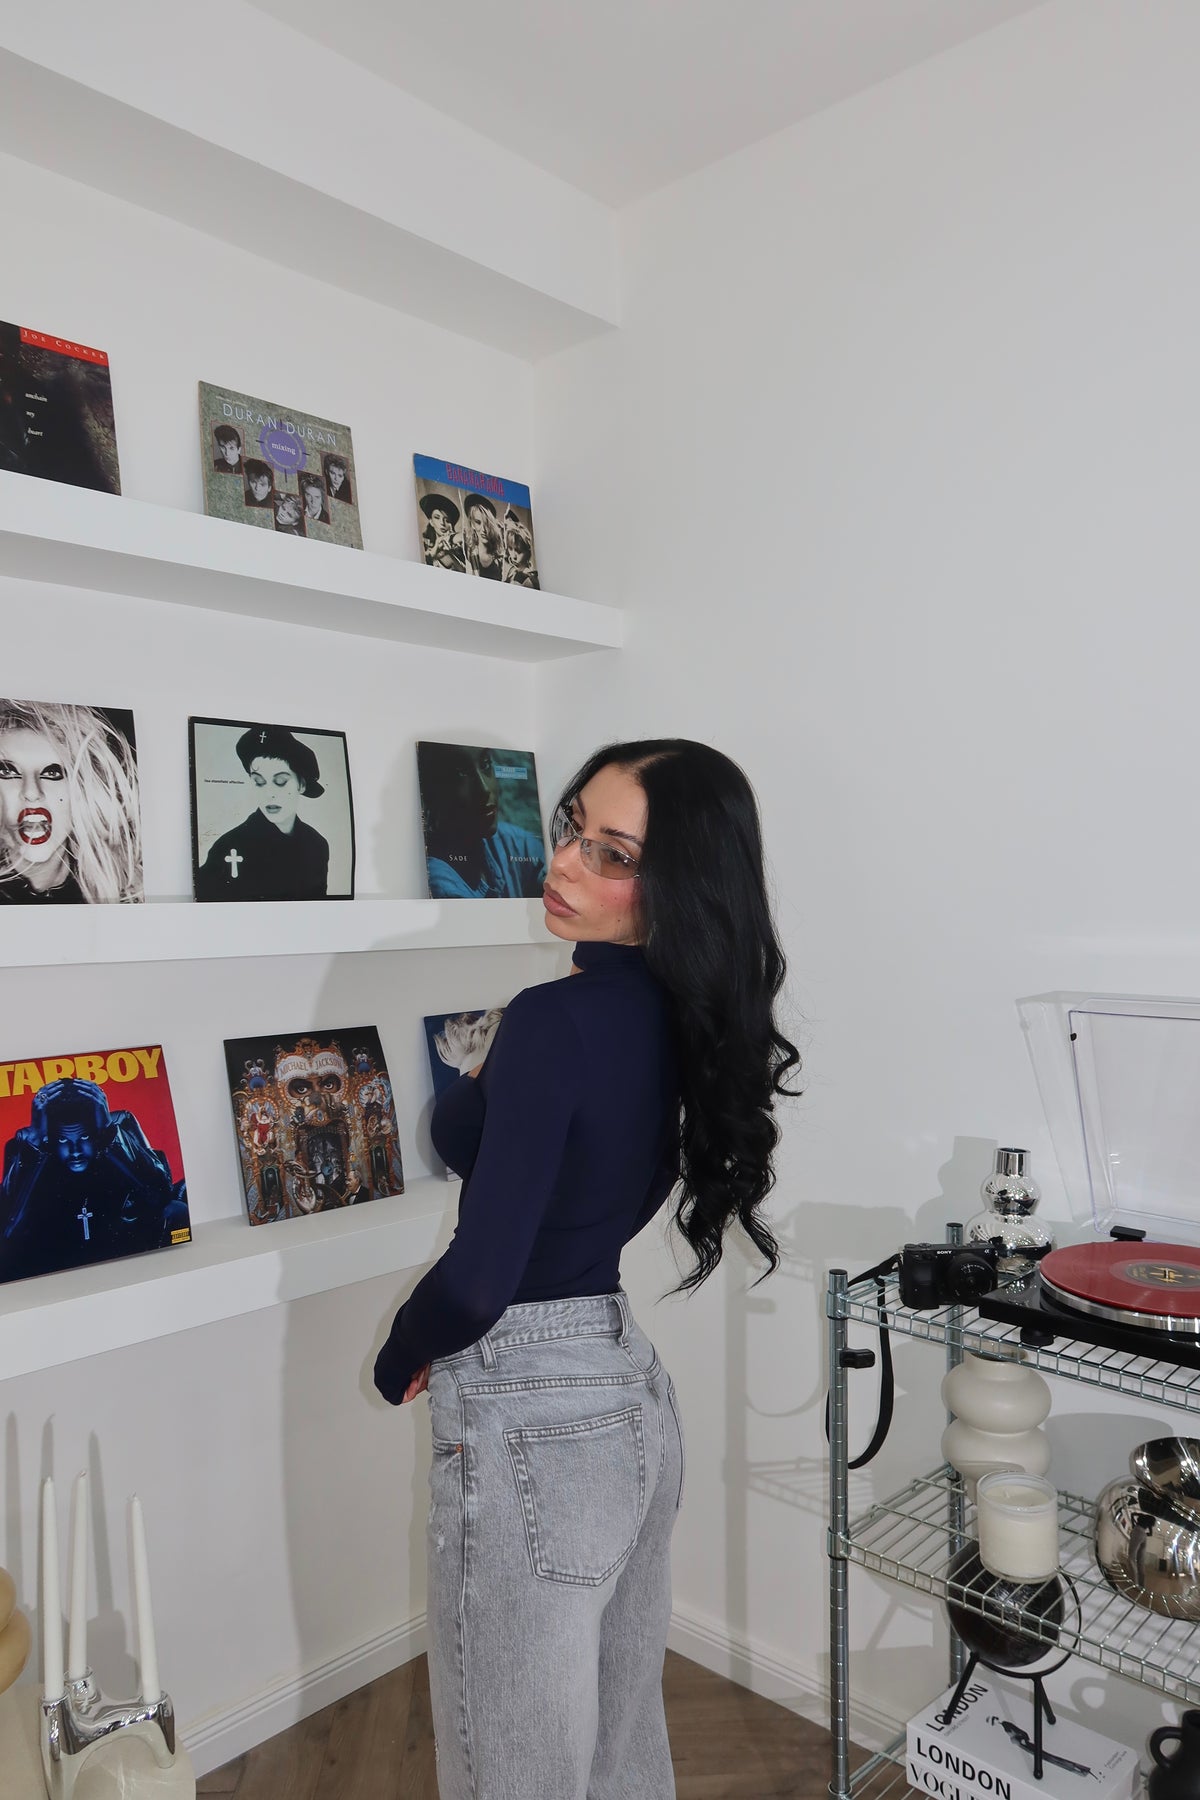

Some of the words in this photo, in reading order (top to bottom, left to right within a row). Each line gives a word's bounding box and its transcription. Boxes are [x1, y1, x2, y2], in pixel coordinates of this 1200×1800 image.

[23, 329, 46, 343] JOE
[55, 340, 105, 359] COCKER
[223, 403, 278, 430] DURAN
[286, 422, 337, 447] DURAN
[271, 442, 296, 455] mixing
[910, 1762, 975, 1800] VOG
[917, 1737, 1010, 1800] LONDON
